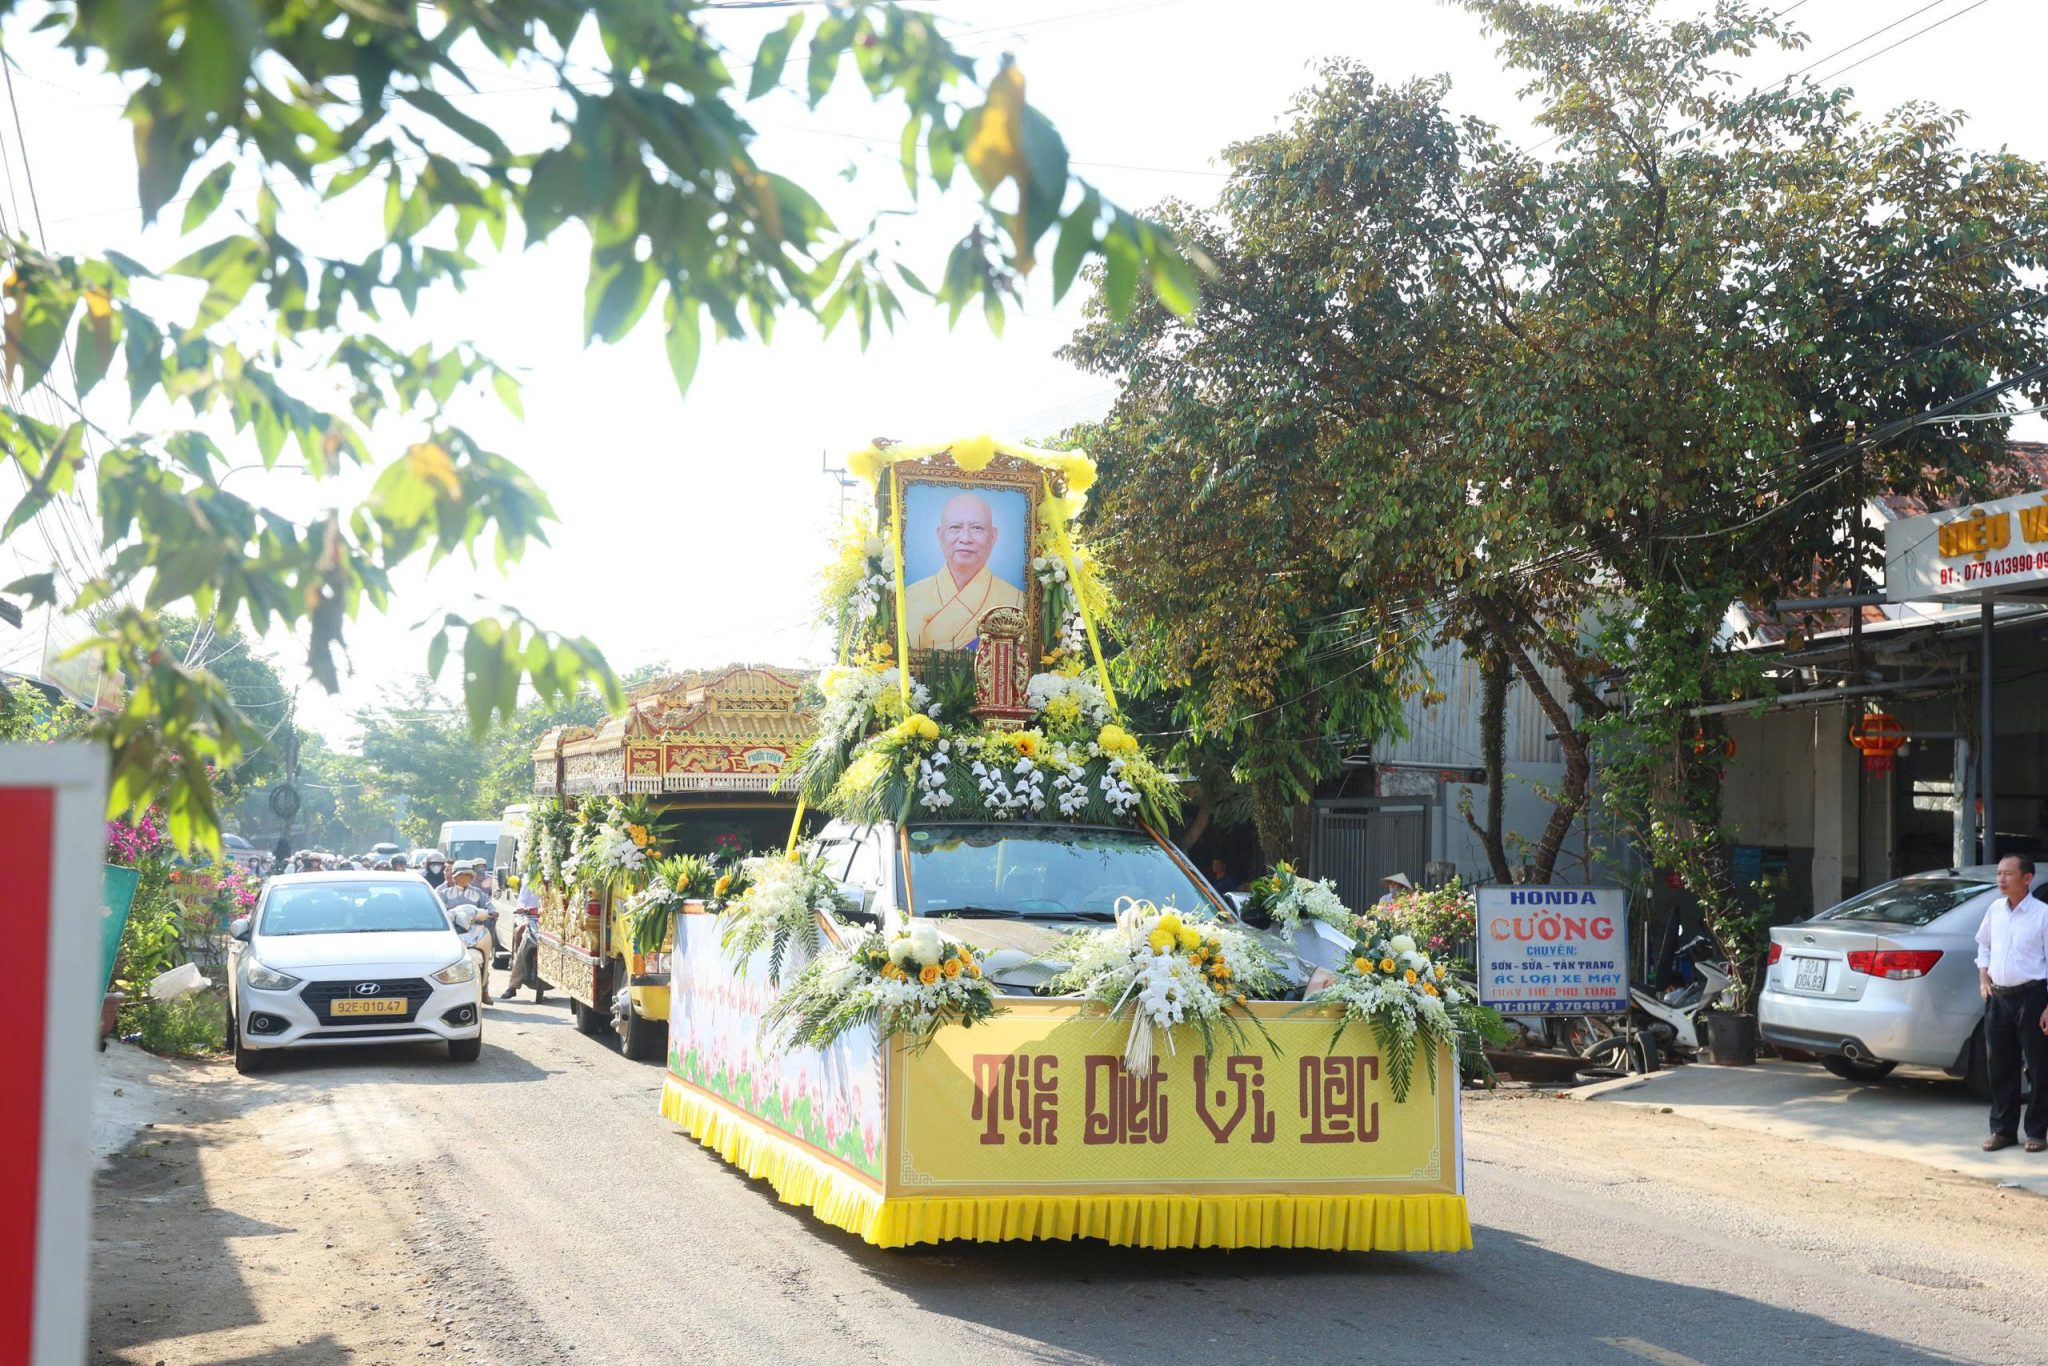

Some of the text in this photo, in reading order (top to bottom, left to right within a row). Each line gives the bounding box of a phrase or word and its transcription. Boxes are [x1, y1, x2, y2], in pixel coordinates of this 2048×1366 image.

[1510, 891, 1596, 905] HONDA
[1489, 909, 1614, 941] CƯỜNG
[1491, 960, 1512, 970] SƠN
[1522, 958, 1543, 970] SỬA
[1577, 961, 1615, 970] TRANG
[1562, 974, 1582, 983] XE
[1588, 972, 1621, 983] MÁY
